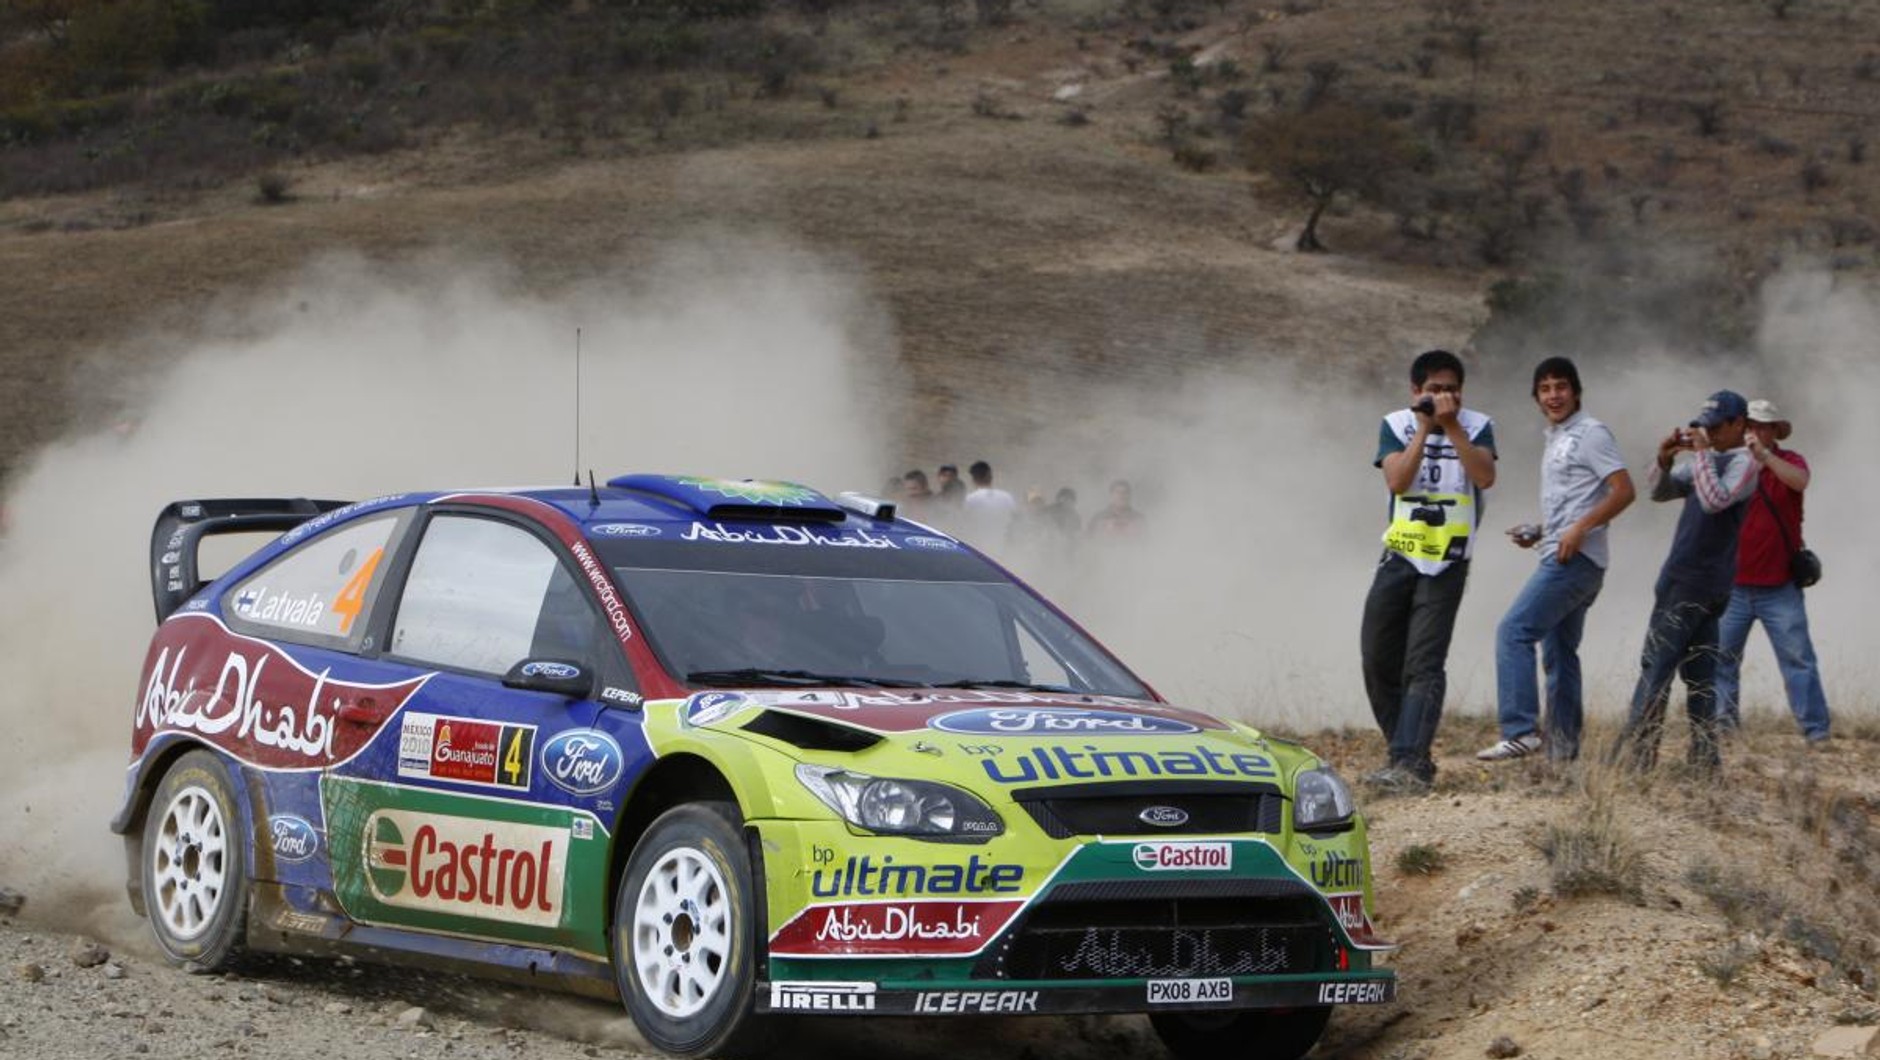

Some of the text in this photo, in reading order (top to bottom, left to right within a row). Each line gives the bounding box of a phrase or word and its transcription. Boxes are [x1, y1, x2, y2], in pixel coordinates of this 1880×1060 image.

[603, 525, 649, 536] Ford
[681, 521, 901, 549] Abu Dhabi
[332, 546, 384, 633] 4
[571, 542, 632, 642] www.wrcford.com
[250, 587, 325, 626] Latvala
[533, 663, 570, 676] Ford
[136, 645, 341, 760] Abu Dhabi
[602, 687, 643, 704] ICEPEAK
[990, 711, 1157, 732] Ford
[435, 741, 495, 767] Guanajuato
[504, 728, 523, 784] 4
[556, 738, 606, 783] Ford
[959, 744, 1004, 757] bp
[981, 745, 1277, 783] ultimate
[1151, 808, 1180, 821] Ford
[272, 822, 308, 856] Ford
[410, 824, 552, 912] Castrol
[813, 845, 835, 865] bp
[1159, 845, 1228, 868] Castrol
[812, 855, 1024, 897] ultimate
[816, 905, 982, 941] Abu Dhabi
[1060, 927, 1158, 976] Abu
[771, 982, 877, 1010] PIRELLI
[914, 992, 1039, 1012] ICEPEAK
[1150, 981, 1231, 1000] PX08 AXB
[1318, 983, 1386, 1004] ICEPEAK
